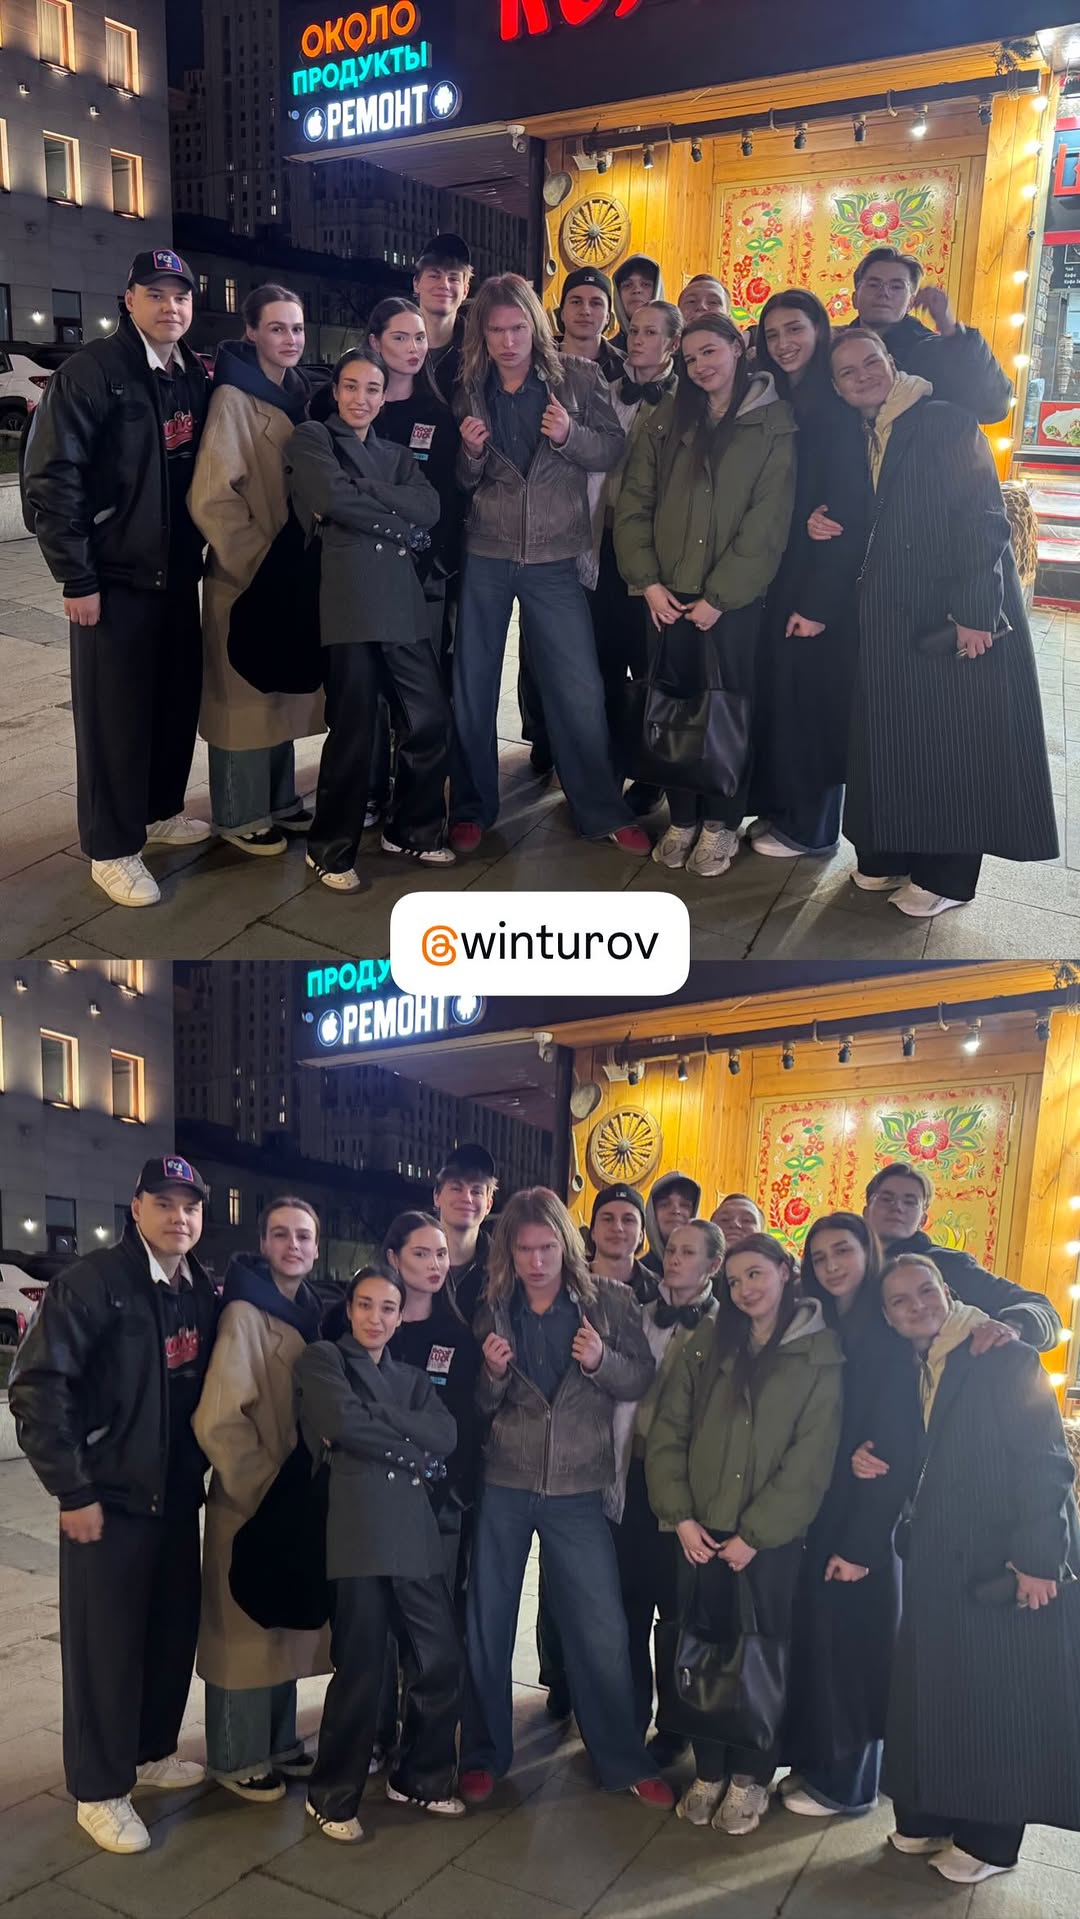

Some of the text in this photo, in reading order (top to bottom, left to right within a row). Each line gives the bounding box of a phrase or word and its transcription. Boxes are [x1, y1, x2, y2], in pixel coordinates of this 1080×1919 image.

[301, 0, 416, 59] ОКОЛО
[292, 40, 428, 96] ПРОДУКТЫ
[326, 84, 429, 140] РЕМОНТ
[343, 994, 447, 1045] РЕМОНТ
